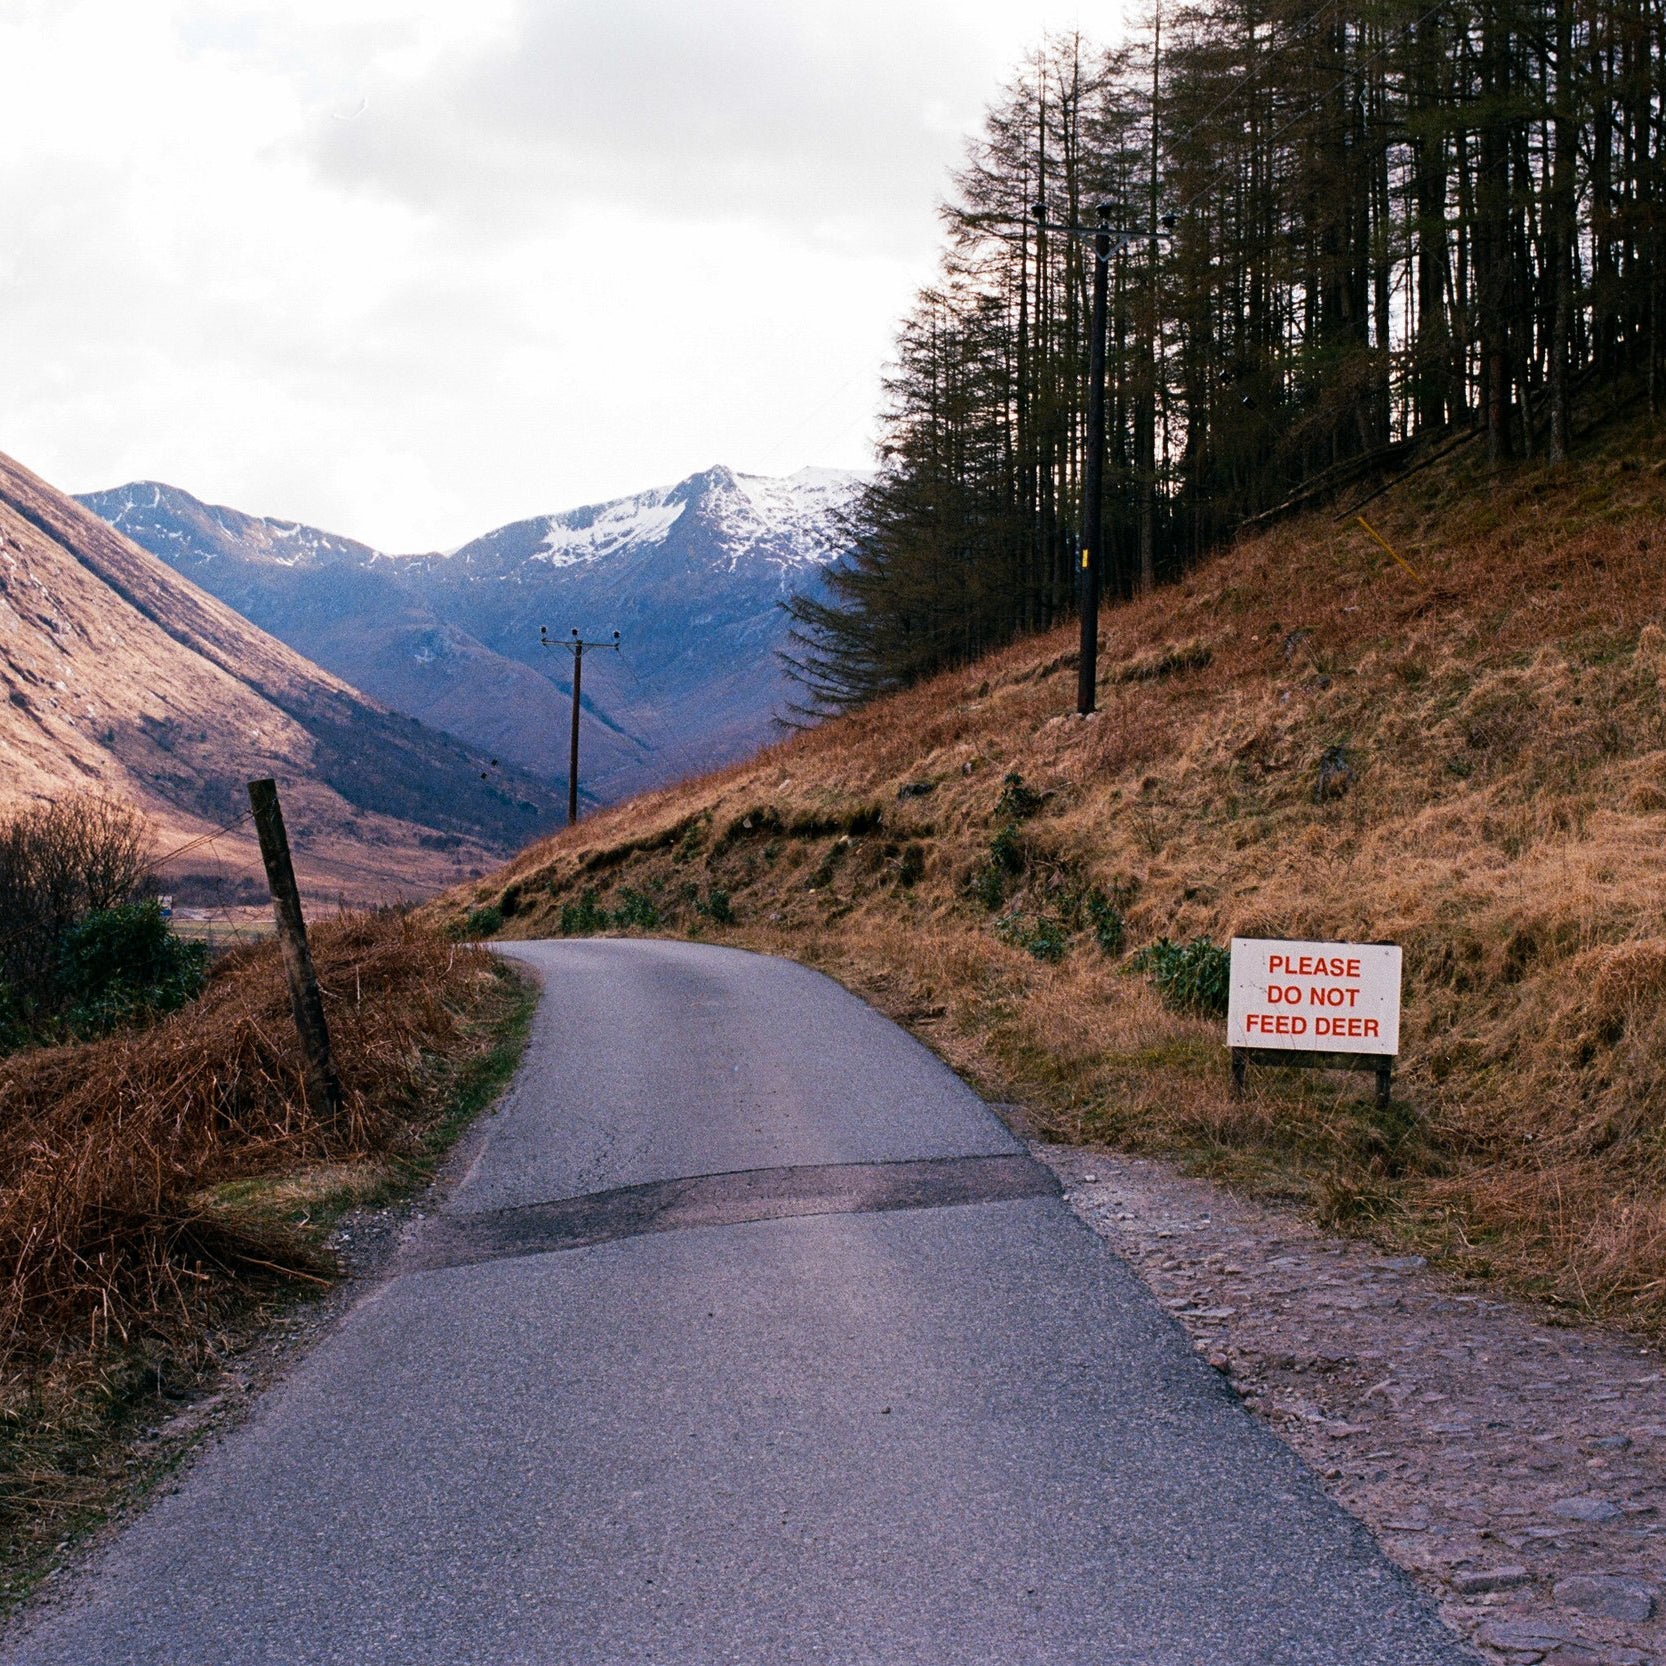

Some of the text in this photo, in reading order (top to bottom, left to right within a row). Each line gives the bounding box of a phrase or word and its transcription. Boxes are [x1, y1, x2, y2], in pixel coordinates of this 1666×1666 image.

[1269, 955, 1361, 978] PLEASE
[1267, 985, 1360, 1007] DO NOT
[1246, 1014, 1379, 1037] FEED DEER
